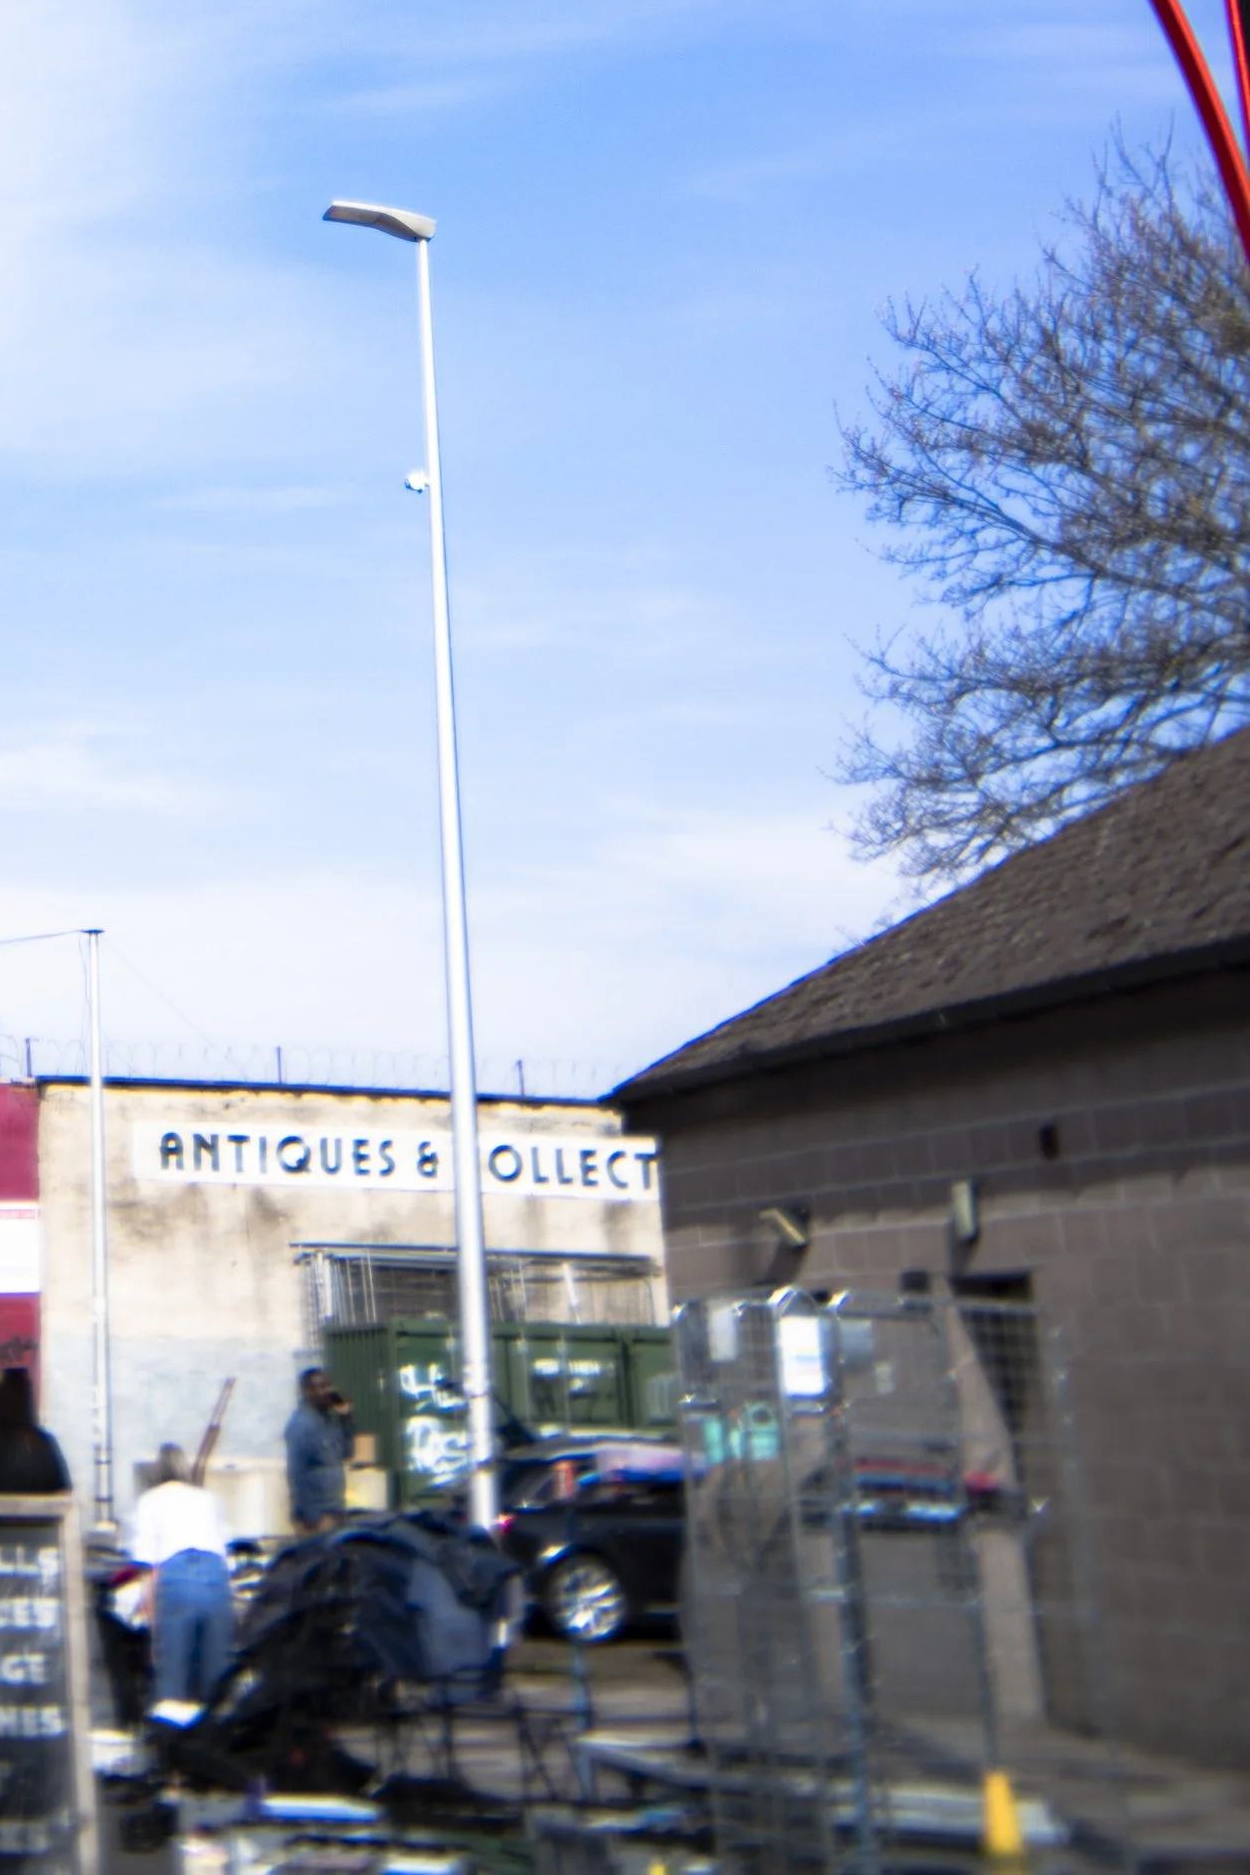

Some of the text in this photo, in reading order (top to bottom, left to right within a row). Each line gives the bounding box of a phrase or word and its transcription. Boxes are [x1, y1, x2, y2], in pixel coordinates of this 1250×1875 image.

[159, 1131, 661, 1191] ANTIQUES & OLLECT
